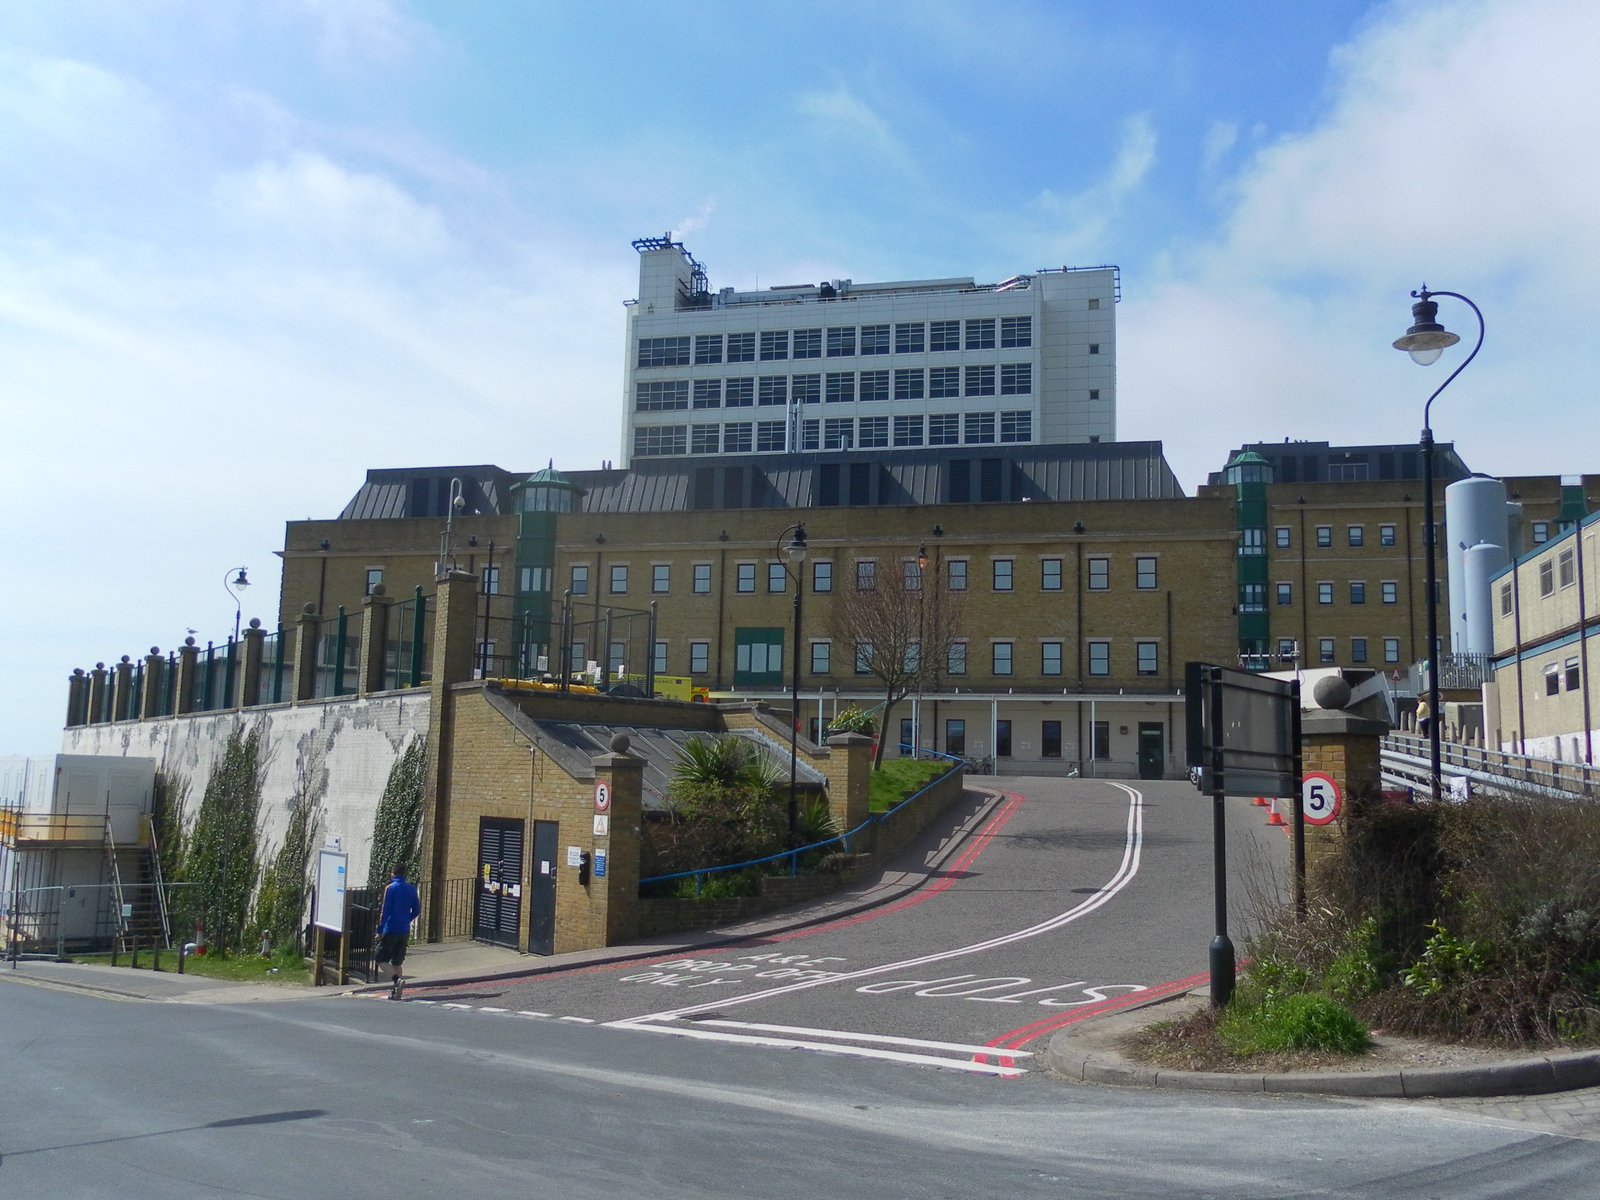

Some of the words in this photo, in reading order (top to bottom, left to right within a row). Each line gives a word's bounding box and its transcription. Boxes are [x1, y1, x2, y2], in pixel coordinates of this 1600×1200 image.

[599, 788, 605, 802] 5
[1310, 785, 1325, 810] 5
[737, 952, 848, 967] A&E
[651, 959, 758, 973] DROP
[755, 968, 848, 980] OFF
[619, 971, 743, 988] ONLY
[855, 974, 1148, 1006] STOP
